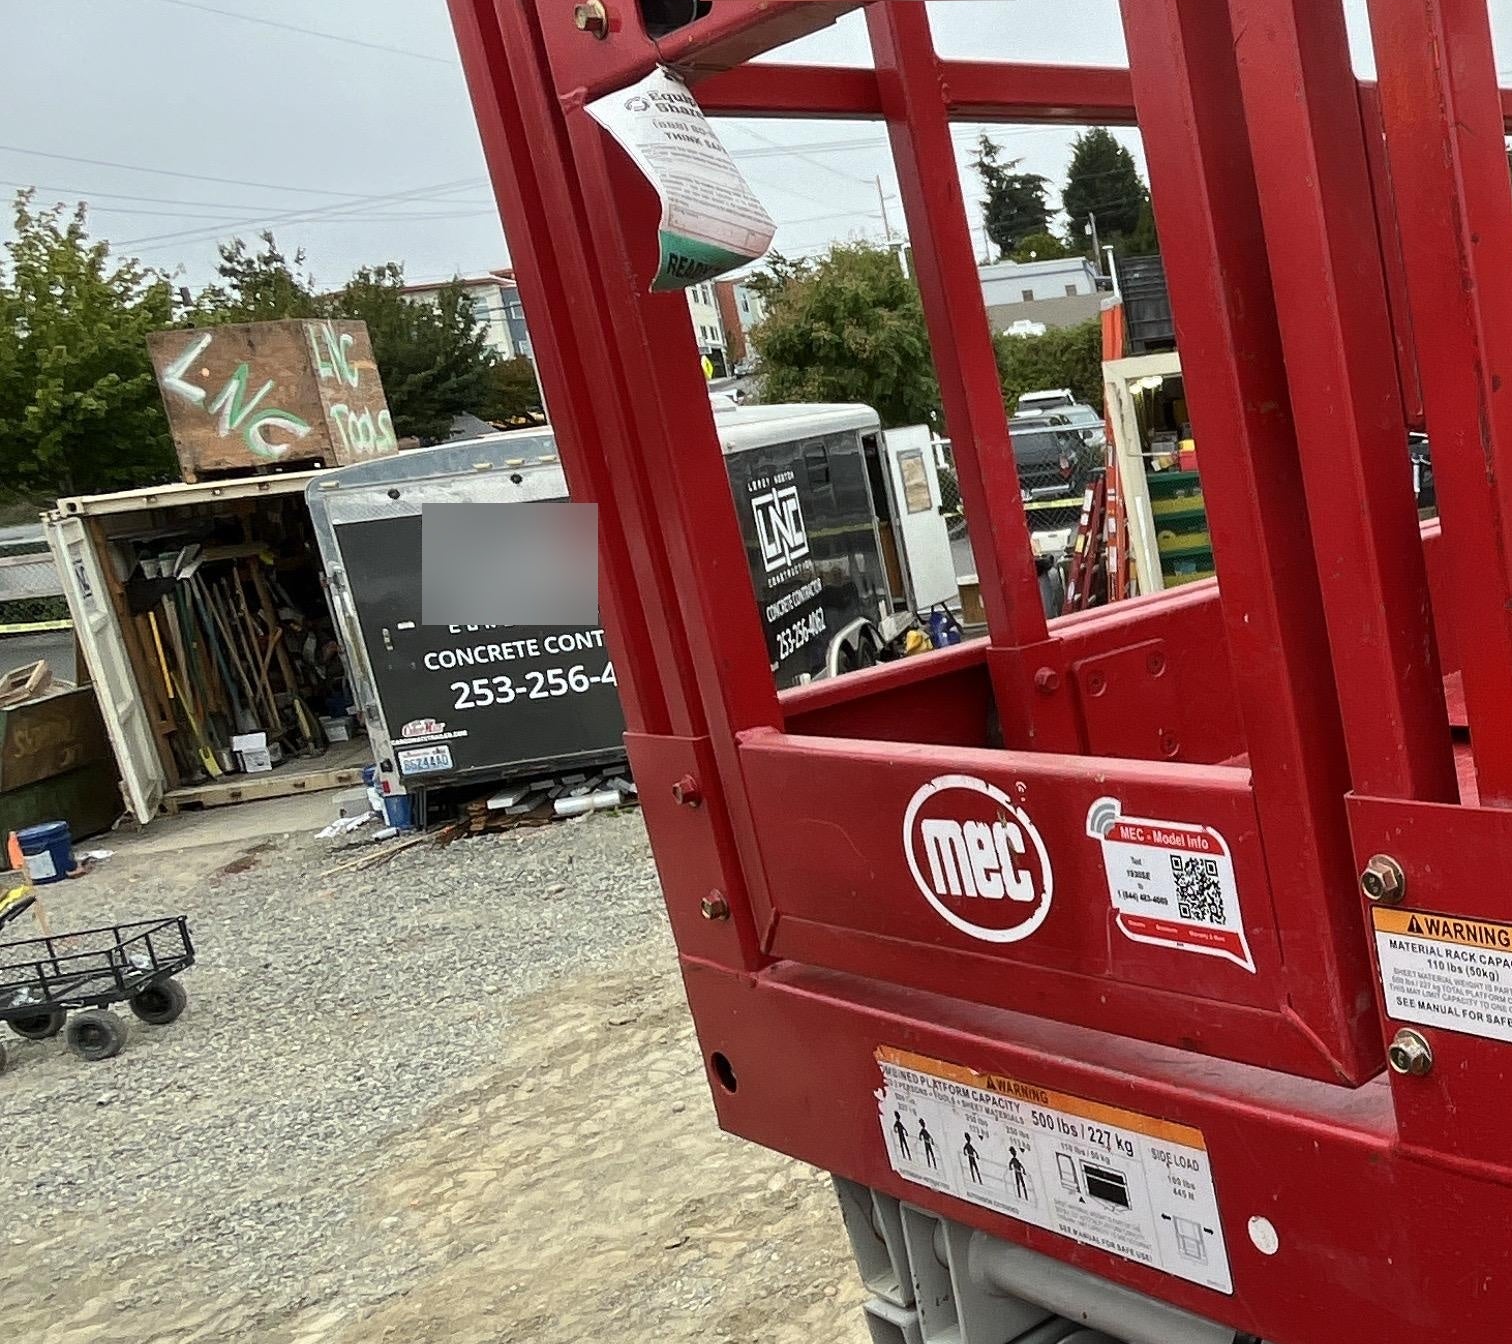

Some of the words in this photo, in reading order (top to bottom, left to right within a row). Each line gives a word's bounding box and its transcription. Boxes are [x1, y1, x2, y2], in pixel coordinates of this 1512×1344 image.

[306, 319, 359, 388] LNC
[161, 332, 313, 459] LNC
[423, 638, 541, 671] CONCRETE
[1120, 825, 1145, 842] MEC
[1151, 830, 1186, 847] Model
[1186, 834, 1210, 850] Info
[1424, 917, 1511, 948] WARNING
[1389, 939, 1444, 958] MATERIAL
[1445, 948, 1476, 964] RACK
[1427, 958, 1445, 971] 110
[1446, 962, 1463, 974] lbs
[1465, 965, 1500, 983] (50kg)
[1442, 984, 1465, 996] TOTAL
[1396, 996, 1416, 1008] SEE
[1417, 1000, 1461, 1017] MANUAL
[1462, 1009, 1484, 1022] FOR
[995, 1078, 1049, 1104] WARNING
[919, 1076, 970, 1098] PLATFORM
[971, 1090, 1021, 1114] CAPACITY
[1031, 1109, 1054, 1131] 500
[1057, 1117, 1078, 1138] lbs
[1087, 1126, 1111, 1147] 227
[1115, 1133, 1134, 1157] kg
[1151, 1147, 1173, 1165] SIDE
[1173, 1155, 1200, 1172] LOAD
